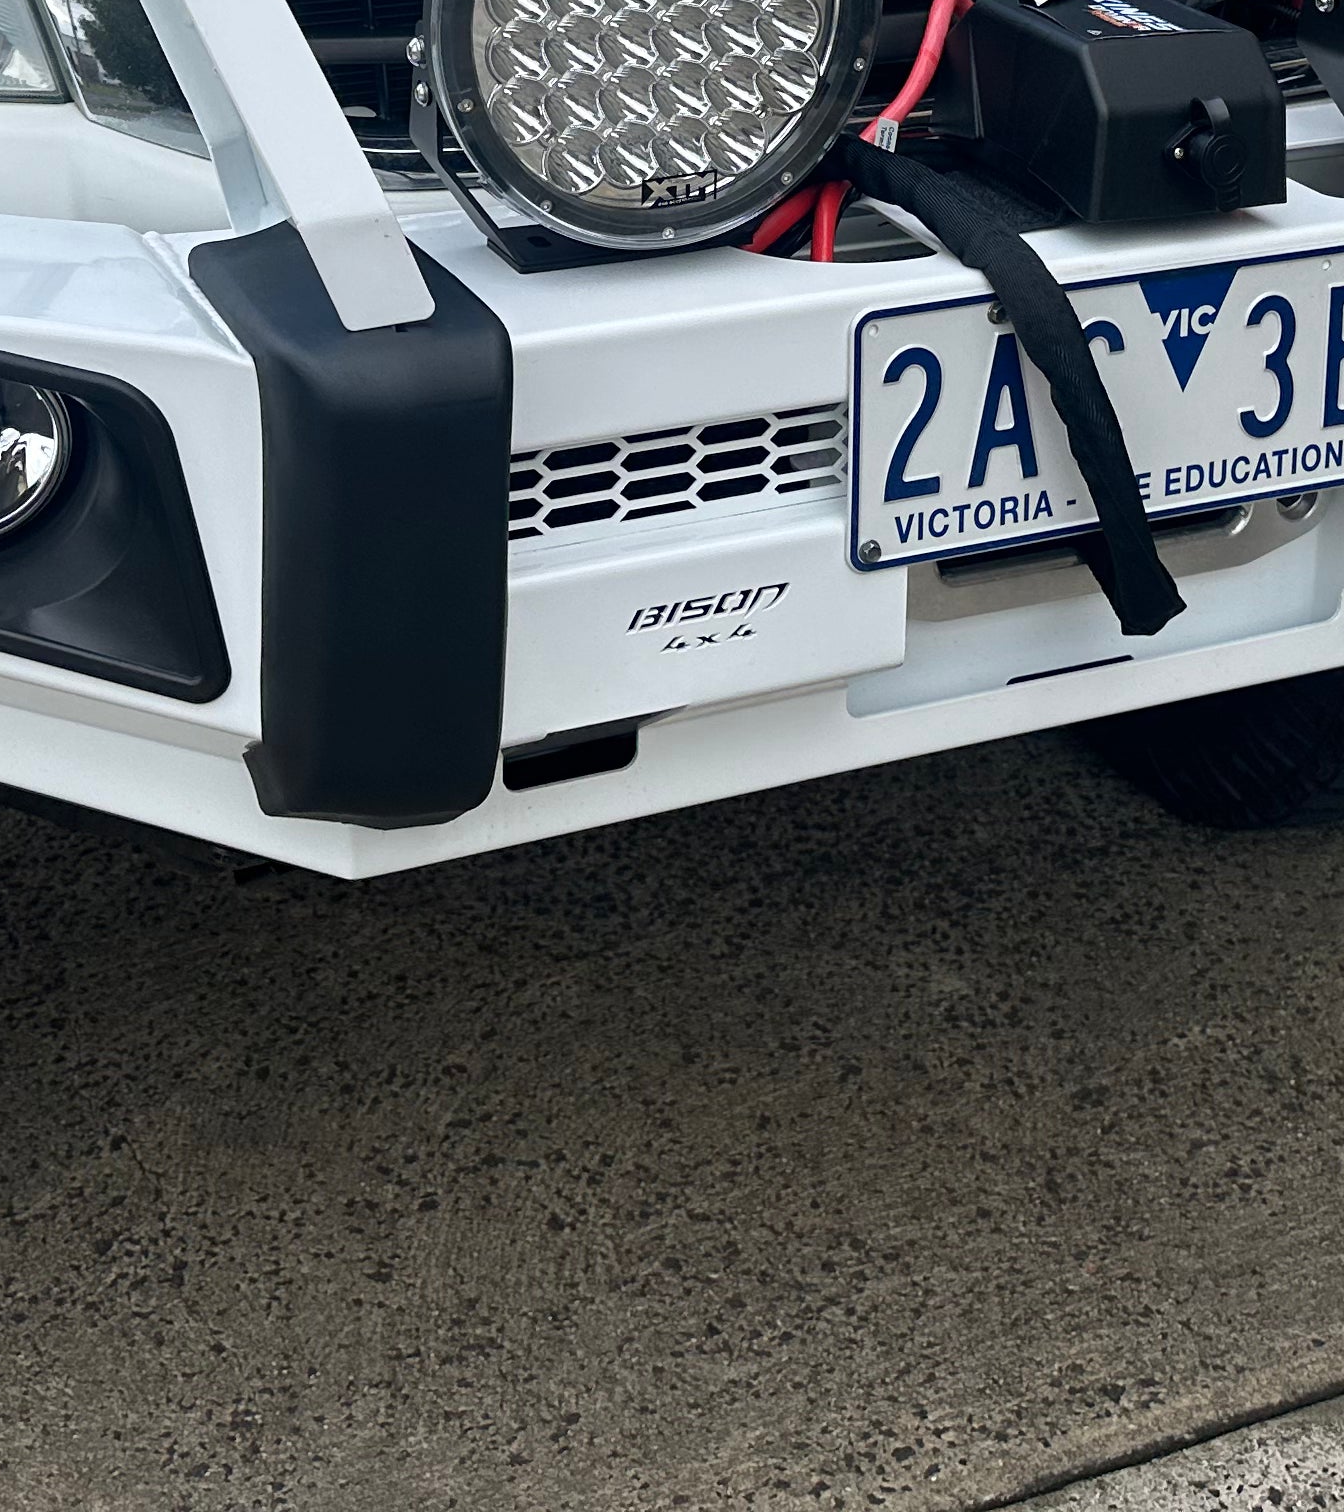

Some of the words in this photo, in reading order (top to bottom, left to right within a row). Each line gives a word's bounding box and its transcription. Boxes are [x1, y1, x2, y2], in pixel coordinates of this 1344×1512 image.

[1157, 303, 1216, 342] VIC
[893, 496, 1054, 545] VICTORIA
[1163, 439, 1344, 498] EDUCATION
[626, 581, 791, 635] BISON
